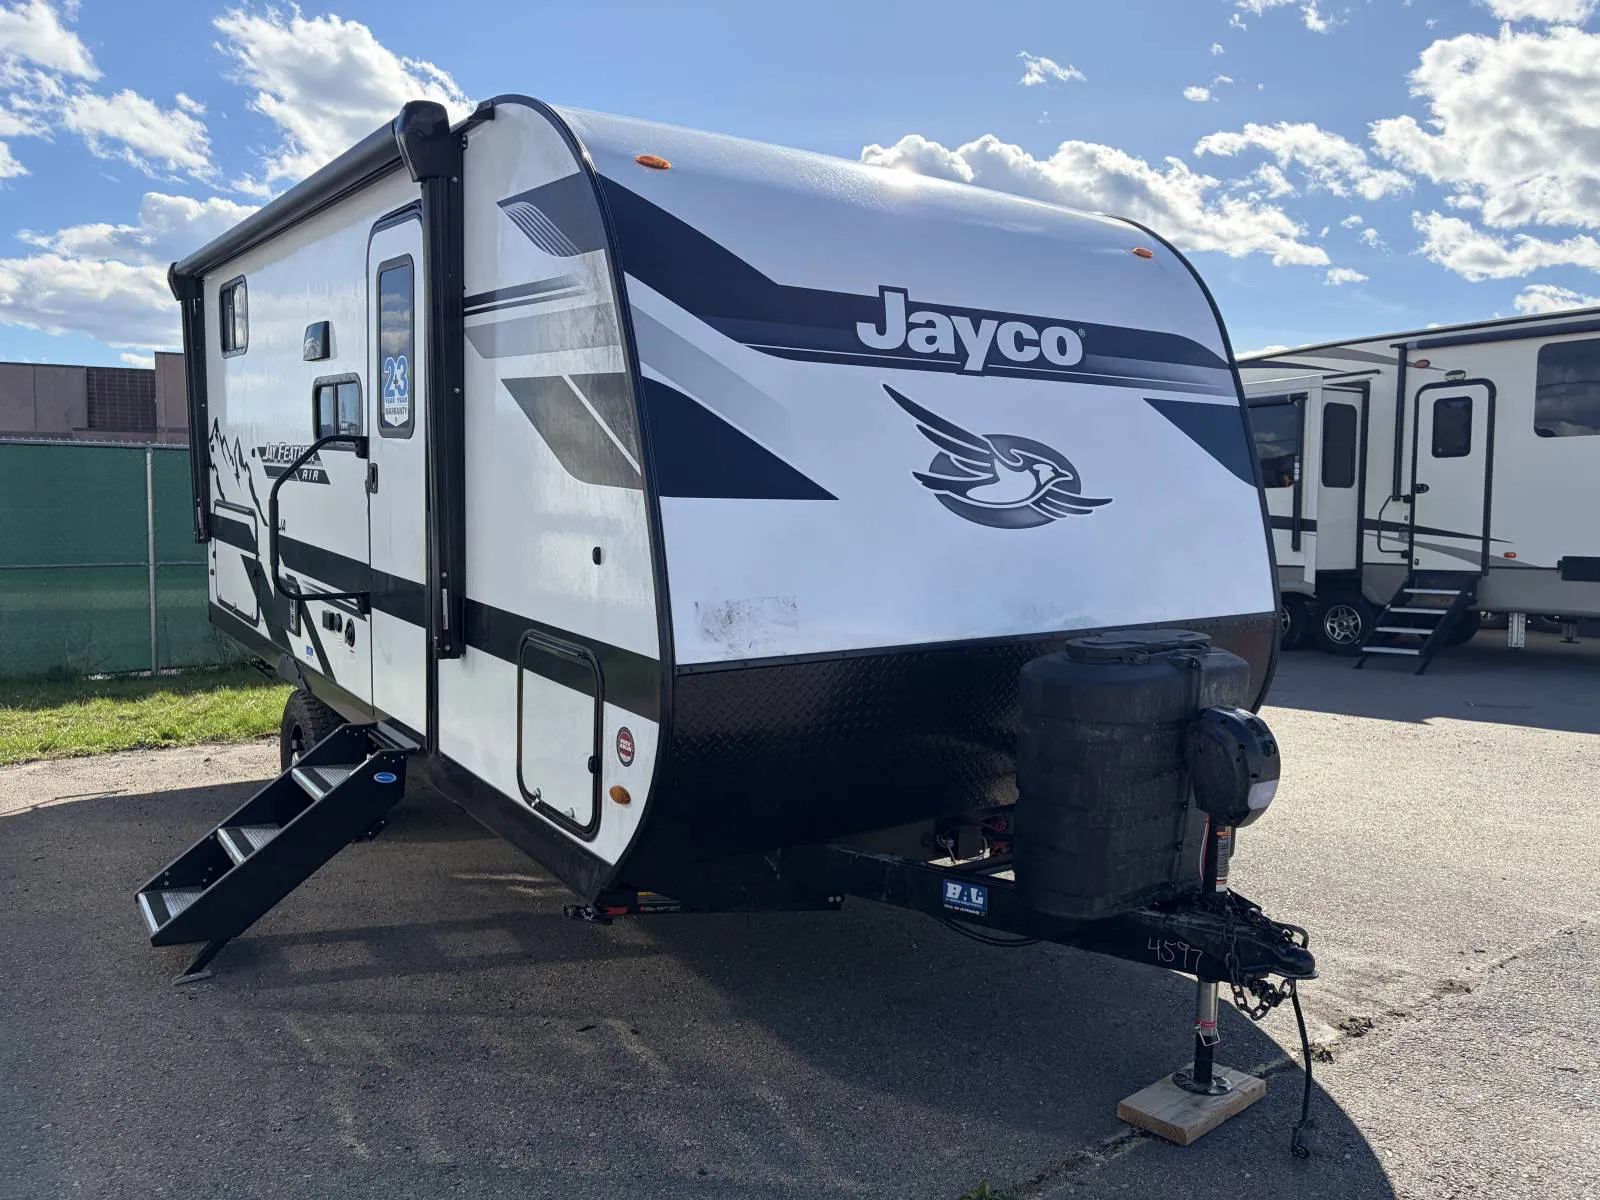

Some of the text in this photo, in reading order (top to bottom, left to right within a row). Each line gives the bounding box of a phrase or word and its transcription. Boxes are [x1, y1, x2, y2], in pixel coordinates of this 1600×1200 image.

[384, 406, 408, 416] WARRANTY
[263, 442, 278, 460] JAY
[302, 469, 319, 481] AIR
[1147, 937, 1204, 972] 4597
